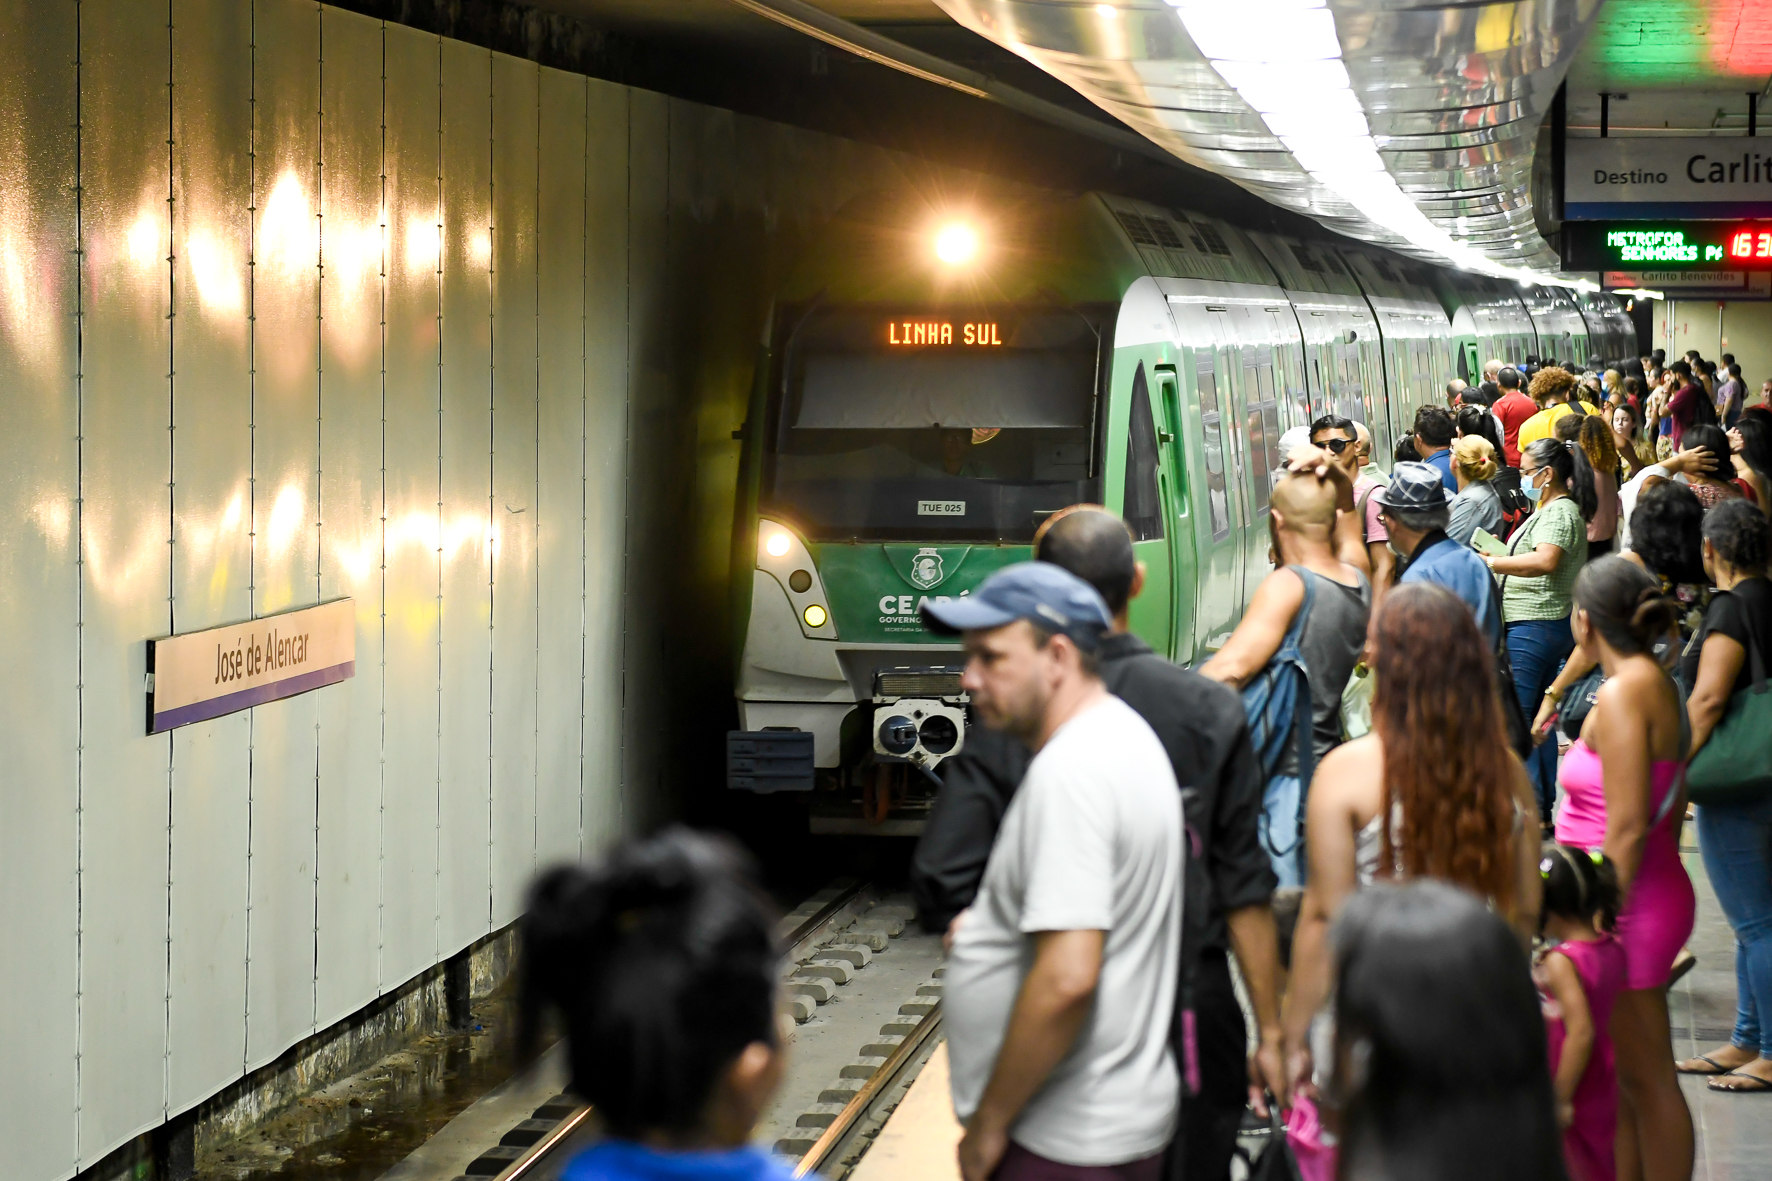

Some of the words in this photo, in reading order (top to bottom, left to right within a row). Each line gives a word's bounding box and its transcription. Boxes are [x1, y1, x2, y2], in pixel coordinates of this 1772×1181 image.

[1594, 169, 1668, 184] Destino
[1607, 231, 1684, 247] METROFOR
[1621, 245, 1698, 261] SENHORES
[1642, 271, 1677, 281] Carlito
[1681, 271, 1735, 281] Benevides
[889, 323, 952, 345] LINHA
[963, 323, 1002, 345] SUL
[922, 504, 942, 512] TUE
[944, 504, 962, 512] 025
[215, 637, 243, 684] José
[246, 633, 262, 677] de
[265, 628, 309, 672] Alencar
